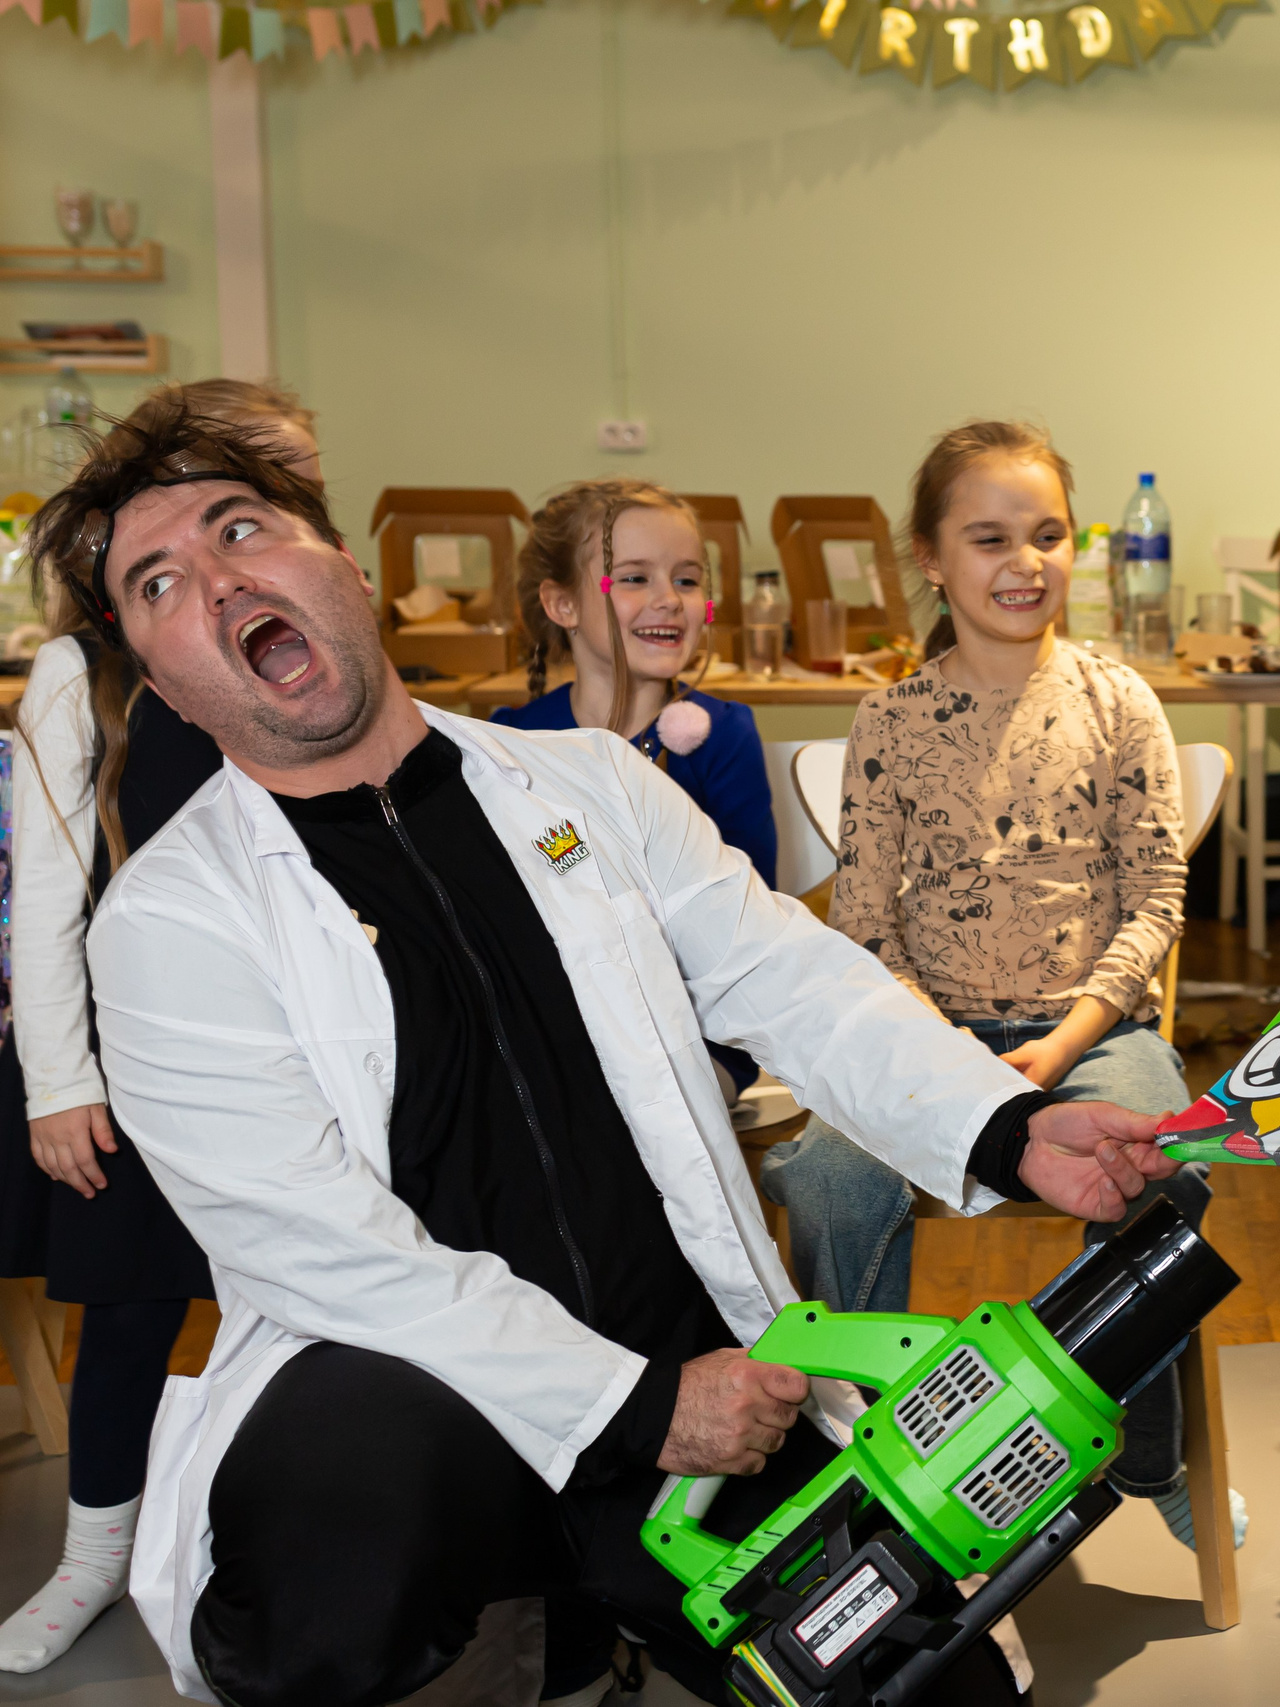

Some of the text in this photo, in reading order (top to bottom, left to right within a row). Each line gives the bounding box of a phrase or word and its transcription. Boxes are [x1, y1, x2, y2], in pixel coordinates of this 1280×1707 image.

[886, 679, 933, 700] CHAOS
[964, 824, 982, 842] ME
[555, 844, 589, 874] KING
[915, 871, 951, 896] CHAOS
